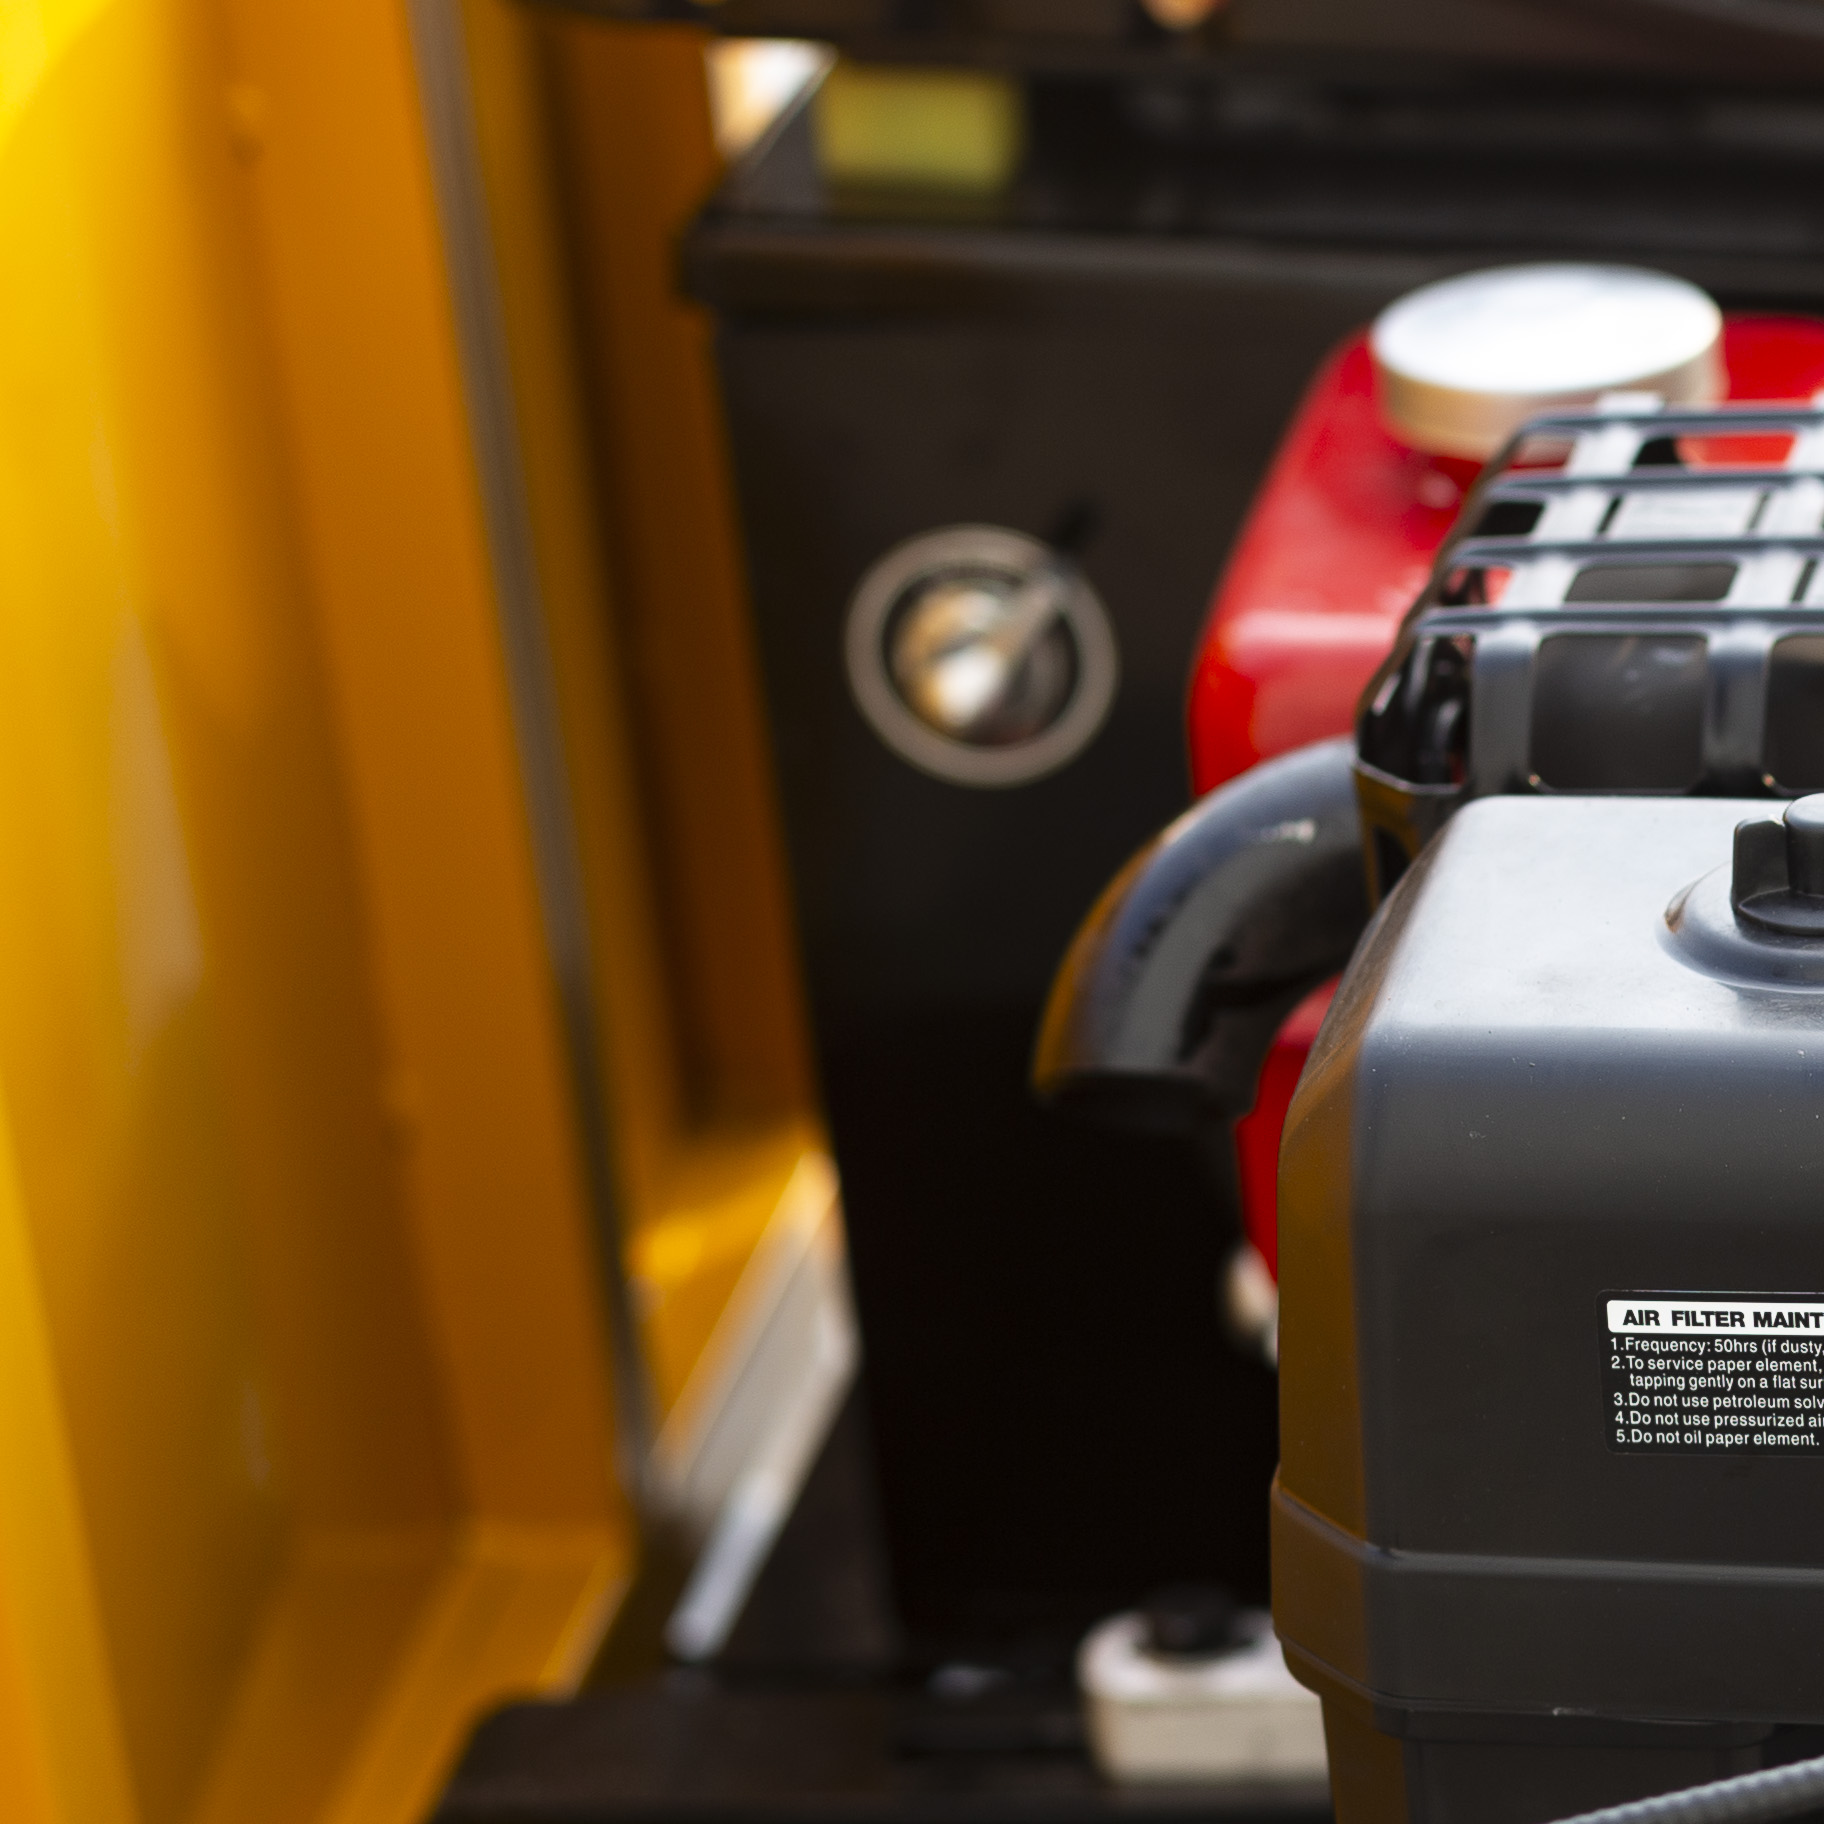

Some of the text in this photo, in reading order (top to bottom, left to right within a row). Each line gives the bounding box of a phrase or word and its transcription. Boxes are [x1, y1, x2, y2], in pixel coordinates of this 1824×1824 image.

[1623, 1310, 1660, 1325] AIR
[1672, 1311, 1745, 1327] FILTER
[1611, 1337, 1710, 1355] 1.Frequency:
[1715, 1339, 1757, 1353] 50hrs
[1762, 1339, 1776, 1356] (if
[1781, 1340, 1824, 1357] dusty,
[1611, 1355, 1644, 1369] 2.To
[1648, 1356, 1703, 1370] service
[1708, 1360, 1752, 1374] paper
[1756, 1358, 1822, 1374] element,
[1630, 1373, 1685, 1390] tapping
[1689, 1374, 1733, 1391] gently
[1738, 1377, 1755, 1388] on
[1760, 1378, 1768, 1388] a
[1773, 1375, 1796, 1389] flat
[1614, 1392, 1650, 1406] 3.Do
[1654, 1394, 1678, 1407] not
[1682, 1397, 1709, 1407] use
[1713, 1395, 1790, 1410] petroleum
[1615, 1411, 1651, 1425] 4.Do
[1655, 1413, 1679, 1425] not
[1683, 1415, 1710, 1426] use
[1714, 1413, 1804, 1429] pressurized
[1617, 1429, 1819, 1447] 5.Do not oil paper element.
